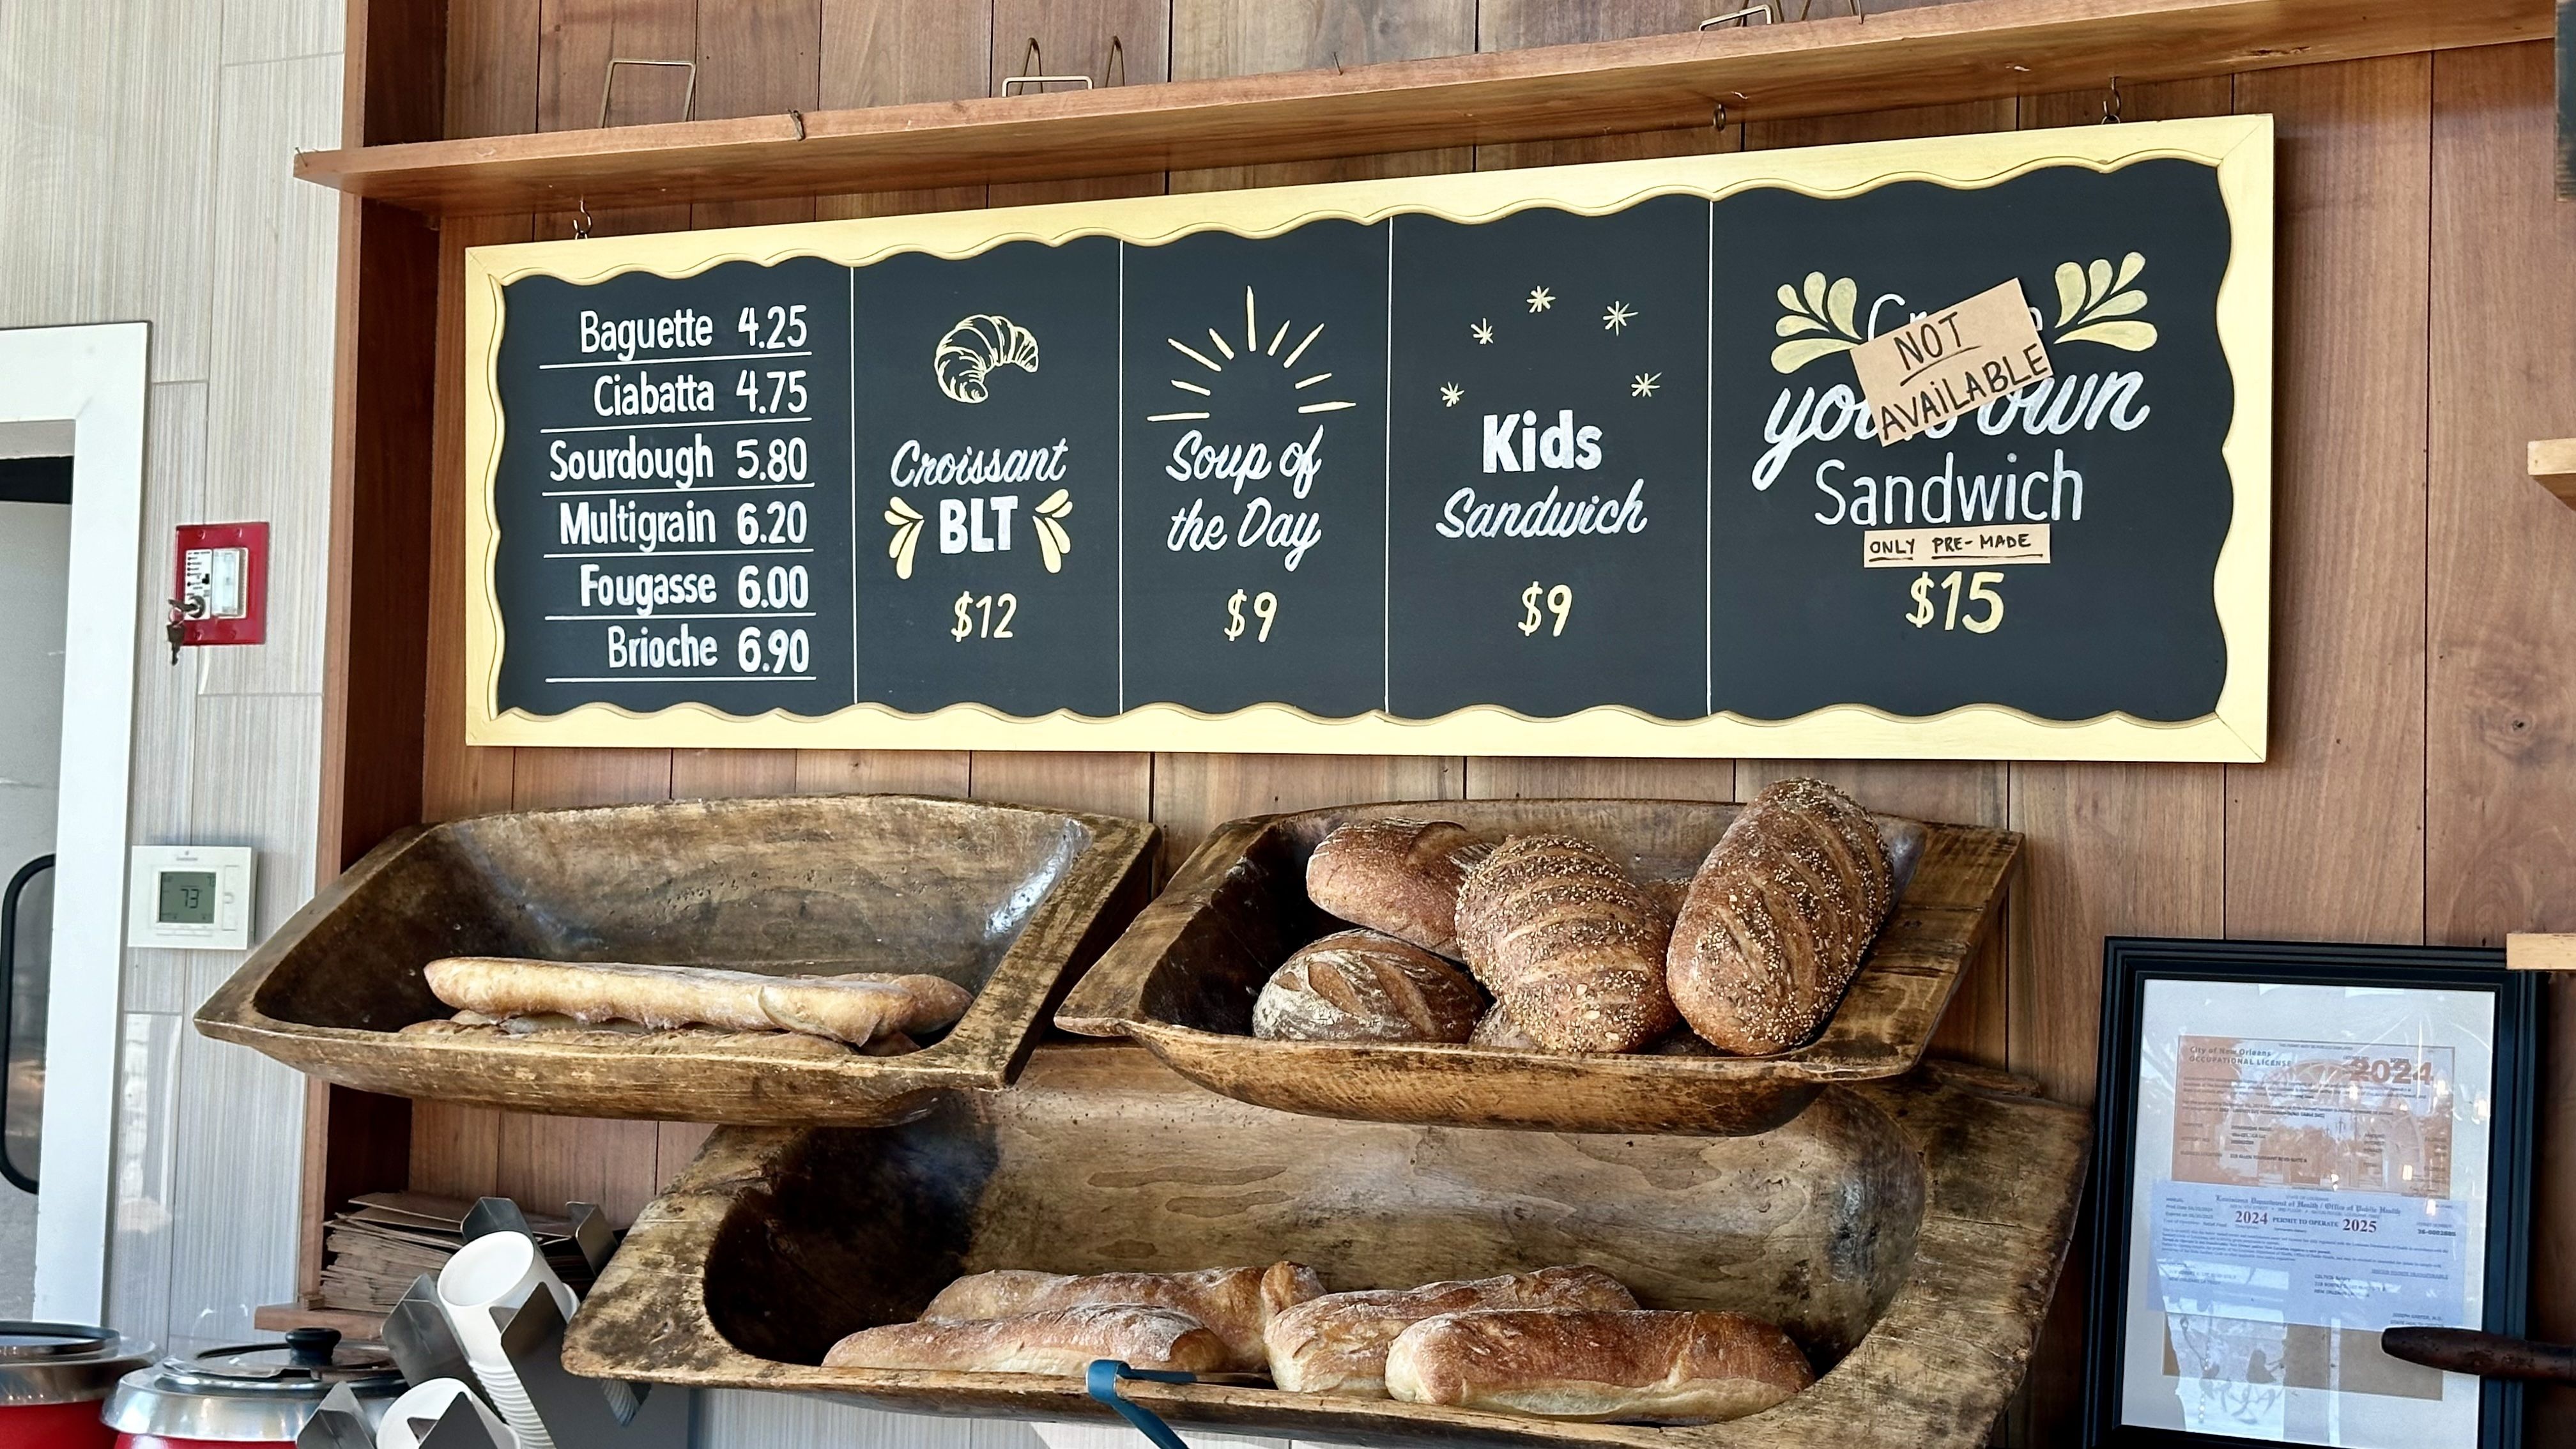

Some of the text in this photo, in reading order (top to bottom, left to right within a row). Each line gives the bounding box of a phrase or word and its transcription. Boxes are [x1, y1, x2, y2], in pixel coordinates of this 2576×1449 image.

[580, 305, 807, 361] Baguette 4.25
[1894, 312, 1958, 371] NOT
[594, 370, 807, 416] Ciabatta 4.75
[549, 433, 807, 489] Sourdough 5.80
[891, 438, 1068, 487] Croissant
[1166, 425, 1323, 499] Soup of
[1483, 410, 1602, 473] Kids
[1436, 479, 1647, 538] Sandwich
[1814, 448, 2083, 526] Sandwich
[560, 498, 807, 553] Multigrain 6.20
[940, 496, 1018, 554] BLT
[1167, 497, 1322, 572] the Day
[1869, 539, 1915, 554] ONLY
[580, 564, 808, 616] Fougasse 6.00
[951, 591, 1016, 642] $12
[1224, 589, 1277, 642] $9
[1518, 581, 1572, 636] $9
[1906, 571, 2004, 633] $15
[608, 624, 809, 674] Brioche 6.90
[181, 889, 199, 908] 73
[2189, 1056, 2254, 1065] OCCUPATIONAL
[2190, 1046, 2206, 1055] City
[2239, 1048, 2271, 1057] Orleans
[2349, 1058, 2434, 1085] 2024
[2235, 1211, 2268, 1225] 2024
[2342, 1218, 2377, 1232] 2025
